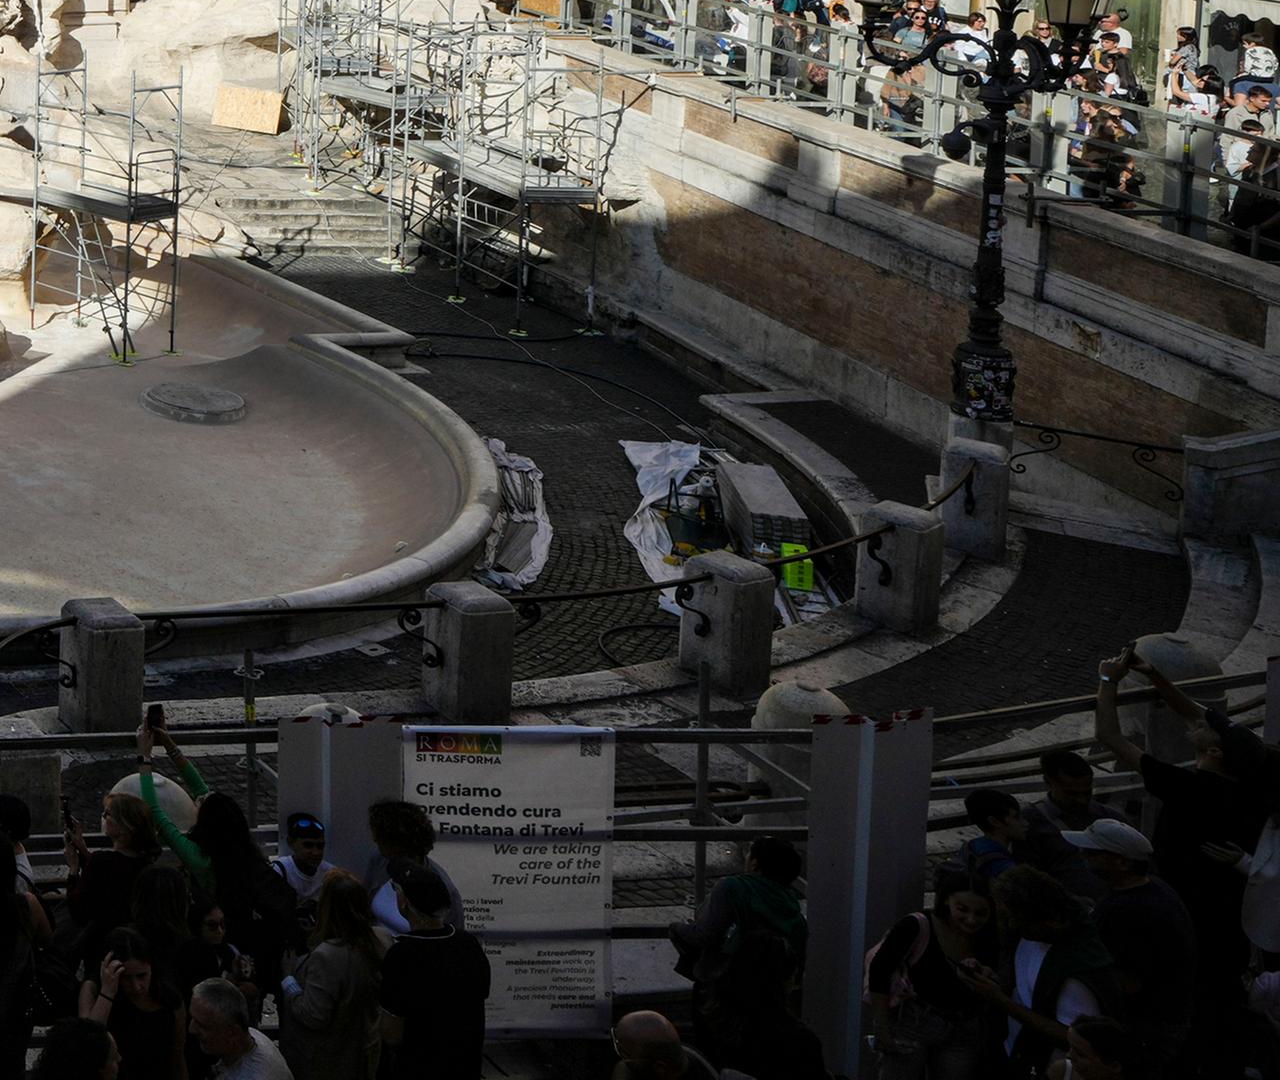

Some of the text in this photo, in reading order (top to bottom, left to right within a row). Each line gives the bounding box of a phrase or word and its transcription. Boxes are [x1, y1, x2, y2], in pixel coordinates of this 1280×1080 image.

[418, 735, 498, 752] ROMA
[416, 753, 502, 765] SI TRASFORMA
[416, 782, 502, 798] Ci stiamo
[522, 807, 561, 818] cura
[439, 822, 584, 837] Fontana di Trevi
[493, 842, 602, 857] We are taking
[519, 857, 601, 870] care of the
[491, 872, 601, 885] Trevi Fountain
